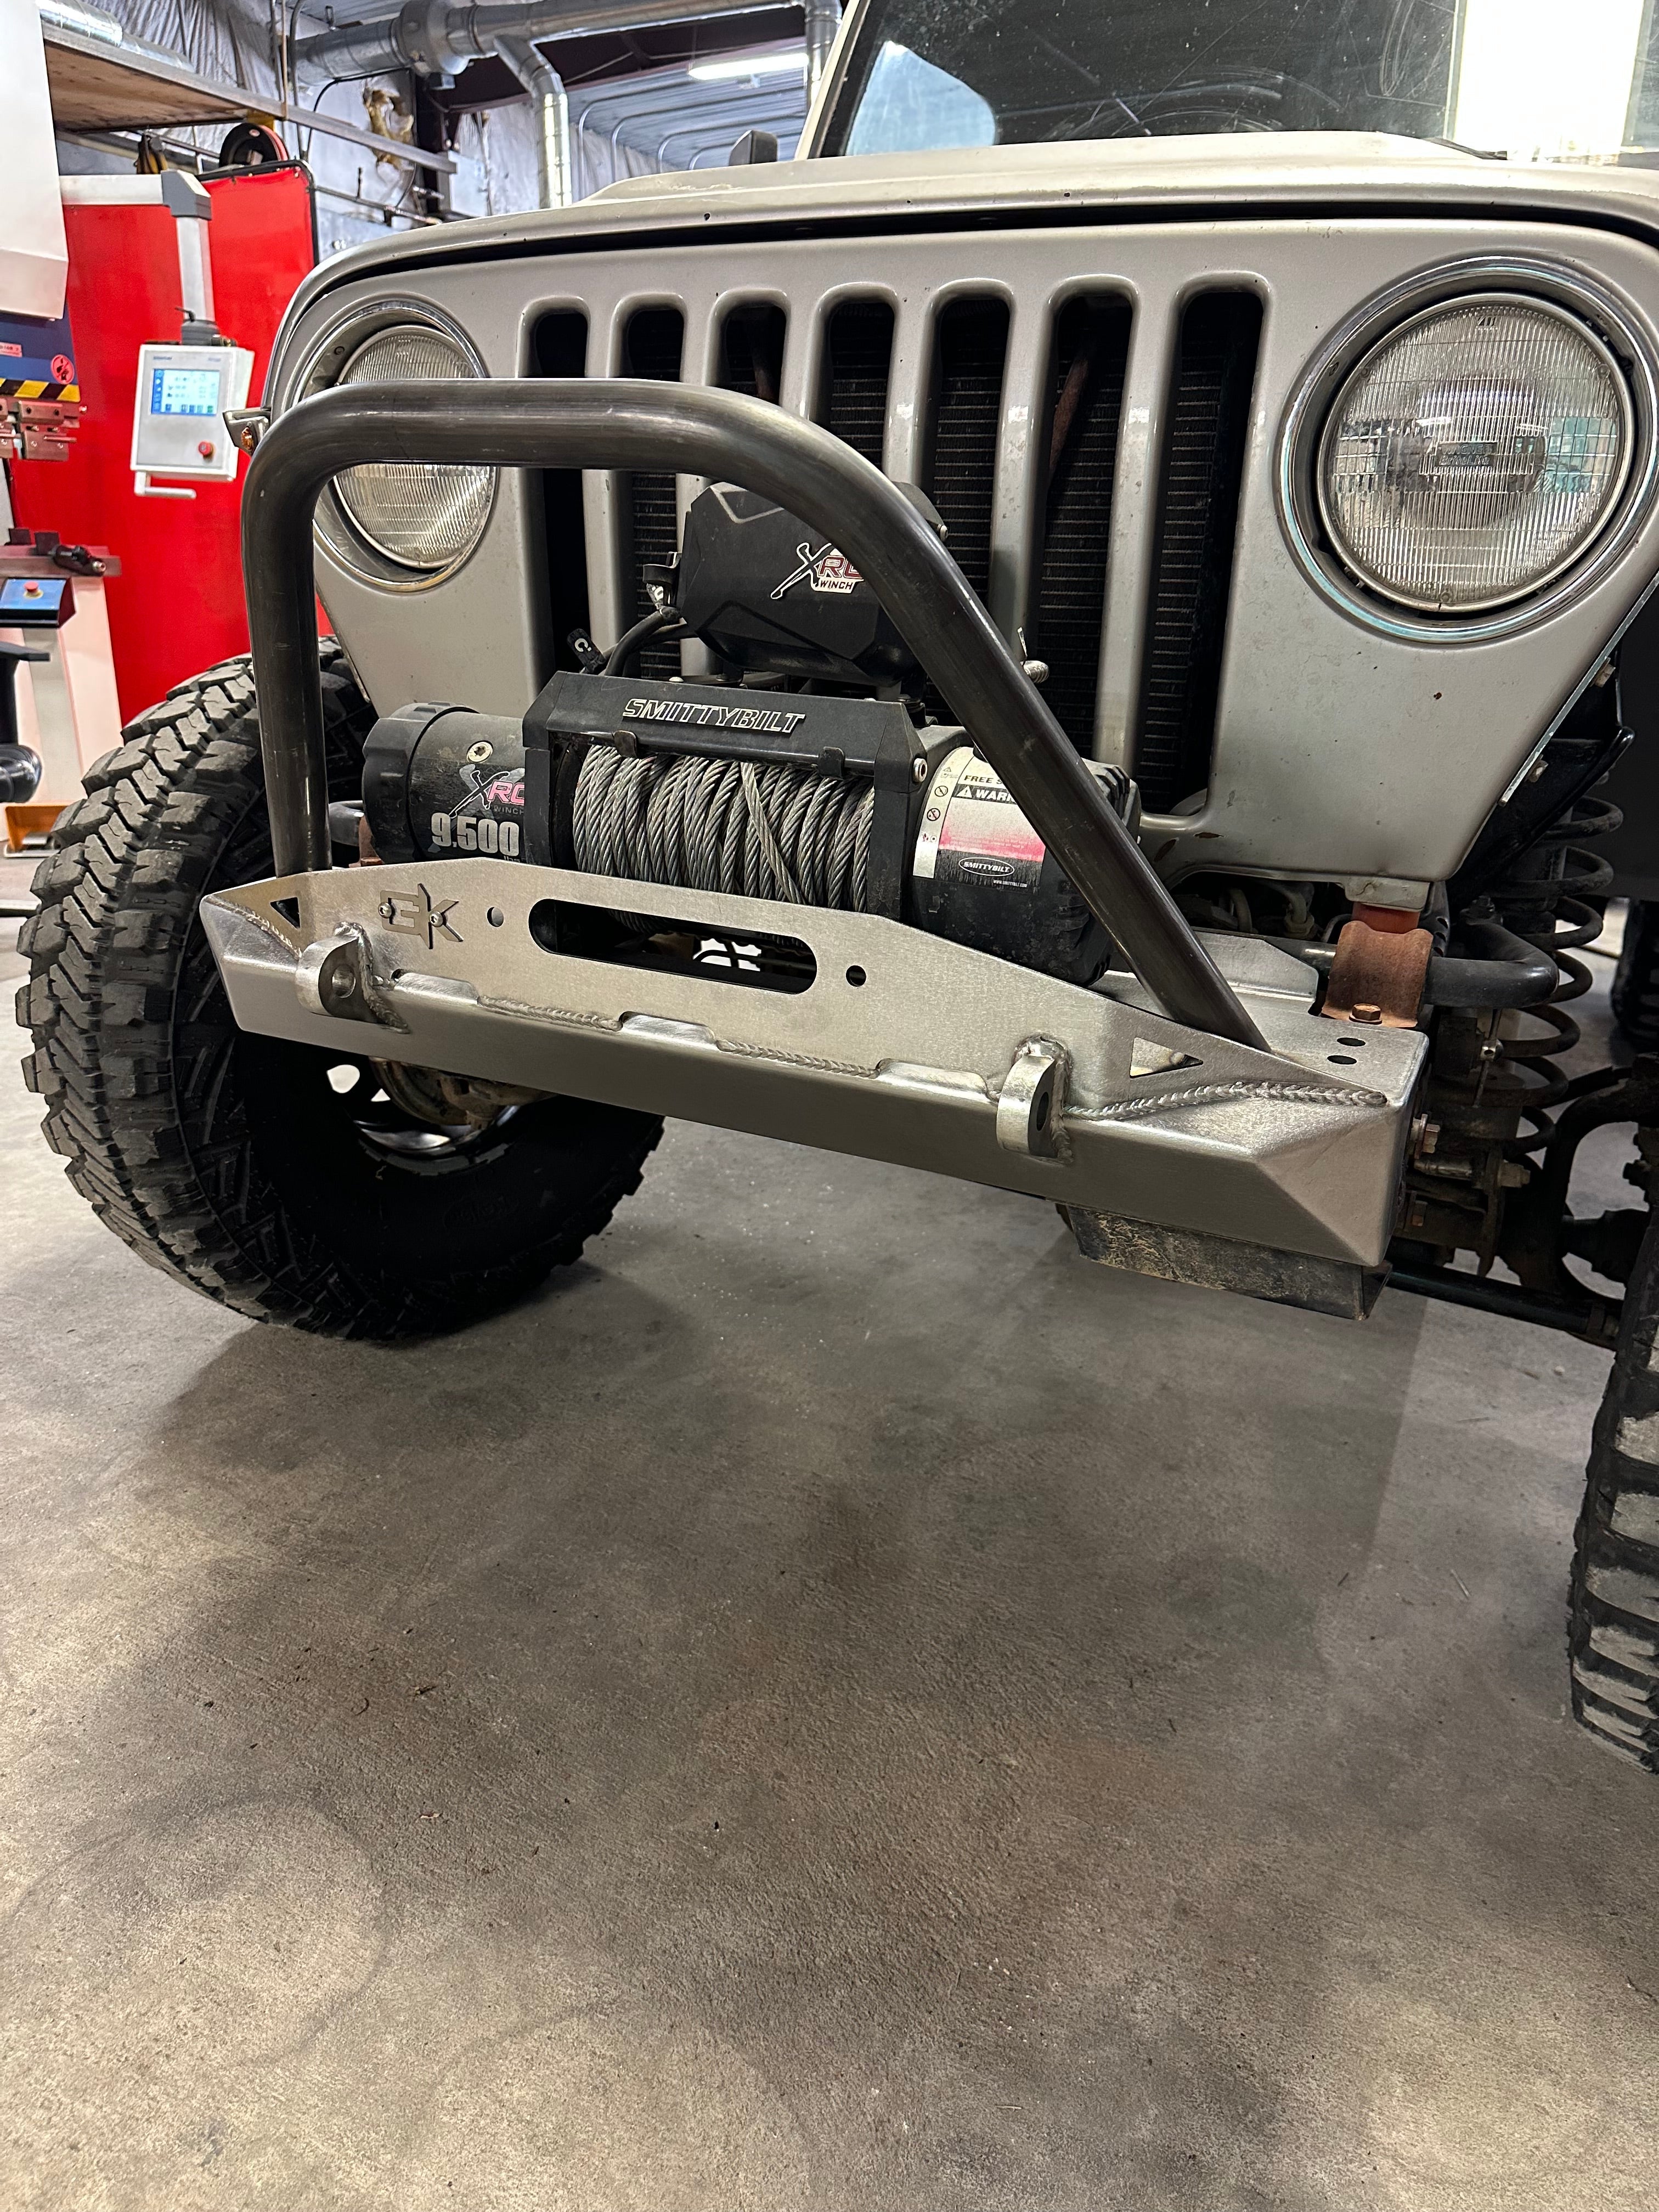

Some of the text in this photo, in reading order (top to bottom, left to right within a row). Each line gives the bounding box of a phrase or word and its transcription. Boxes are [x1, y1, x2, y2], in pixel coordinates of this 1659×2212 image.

[820, 580, 854, 590] WINCH
[622, 698, 806, 733] SMITTYBILT
[964, 775, 994, 783] FREE
[963, 861, 1010, 873] SMITTYBILT
